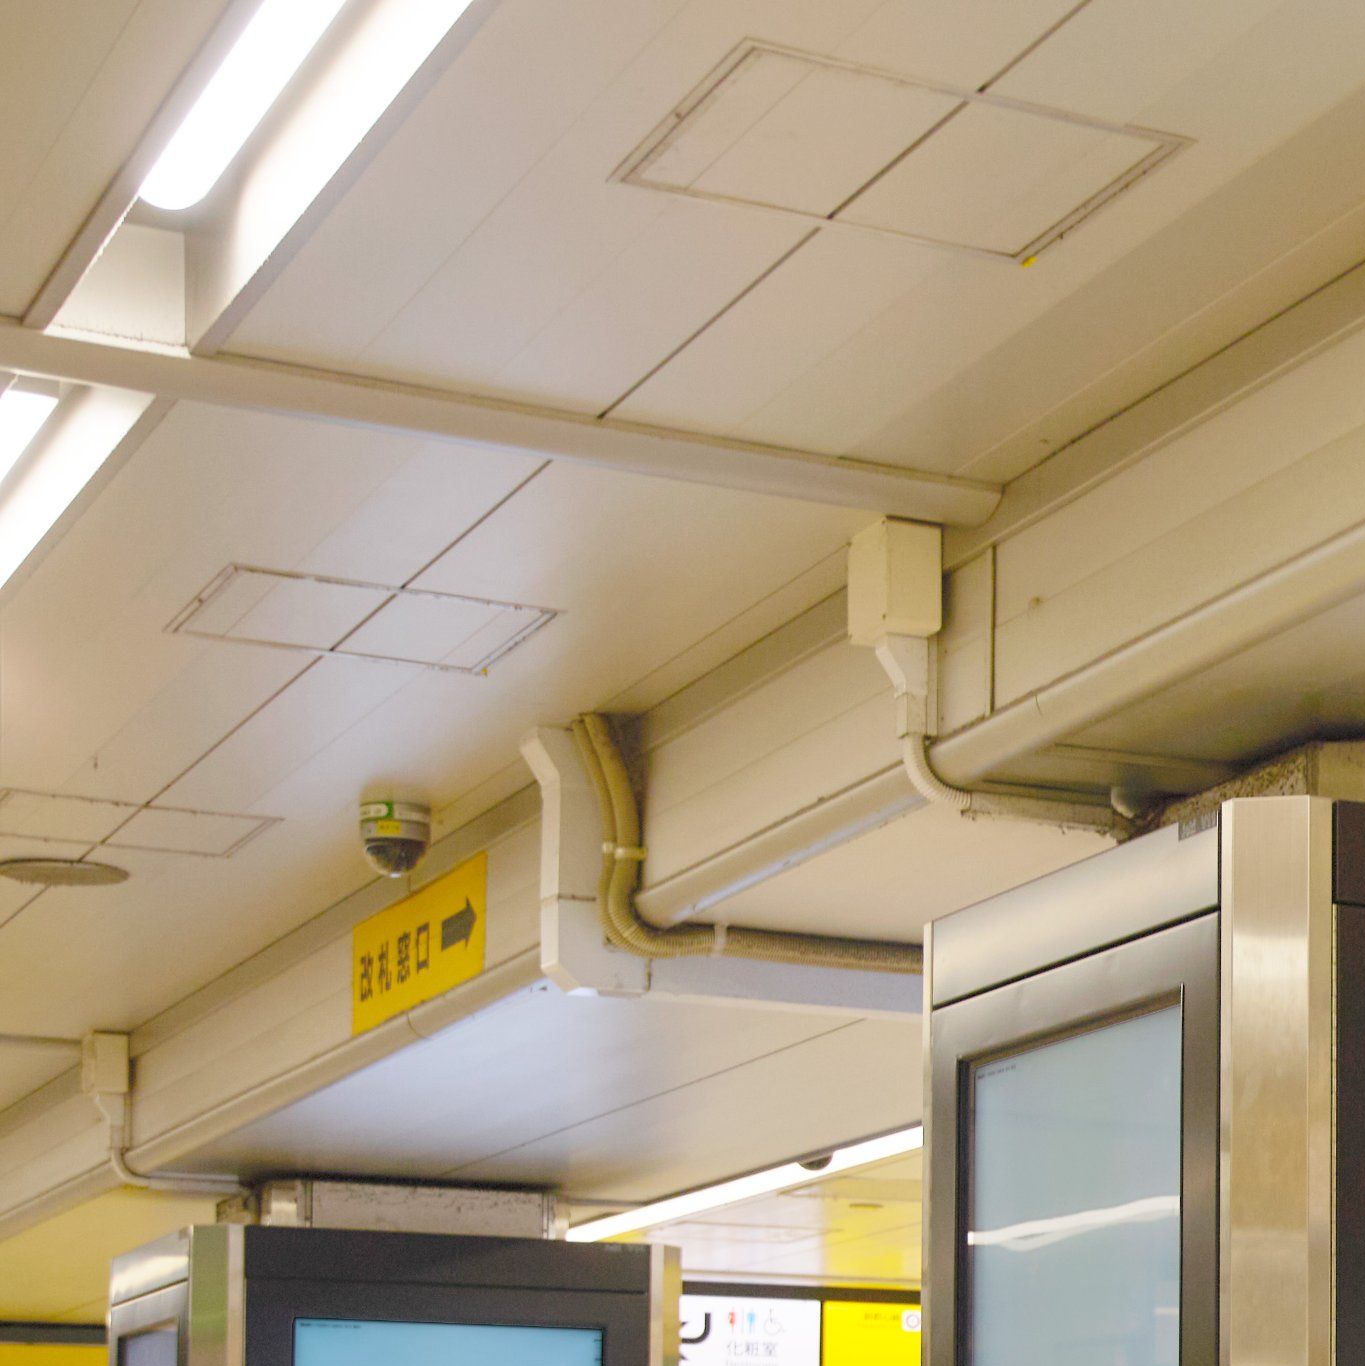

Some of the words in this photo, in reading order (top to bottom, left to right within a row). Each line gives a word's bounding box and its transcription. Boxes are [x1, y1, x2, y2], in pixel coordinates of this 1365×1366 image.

[359, 922, 431, 1003] 改札窓口
[726, 1341, 779, 1358] 化粧室
